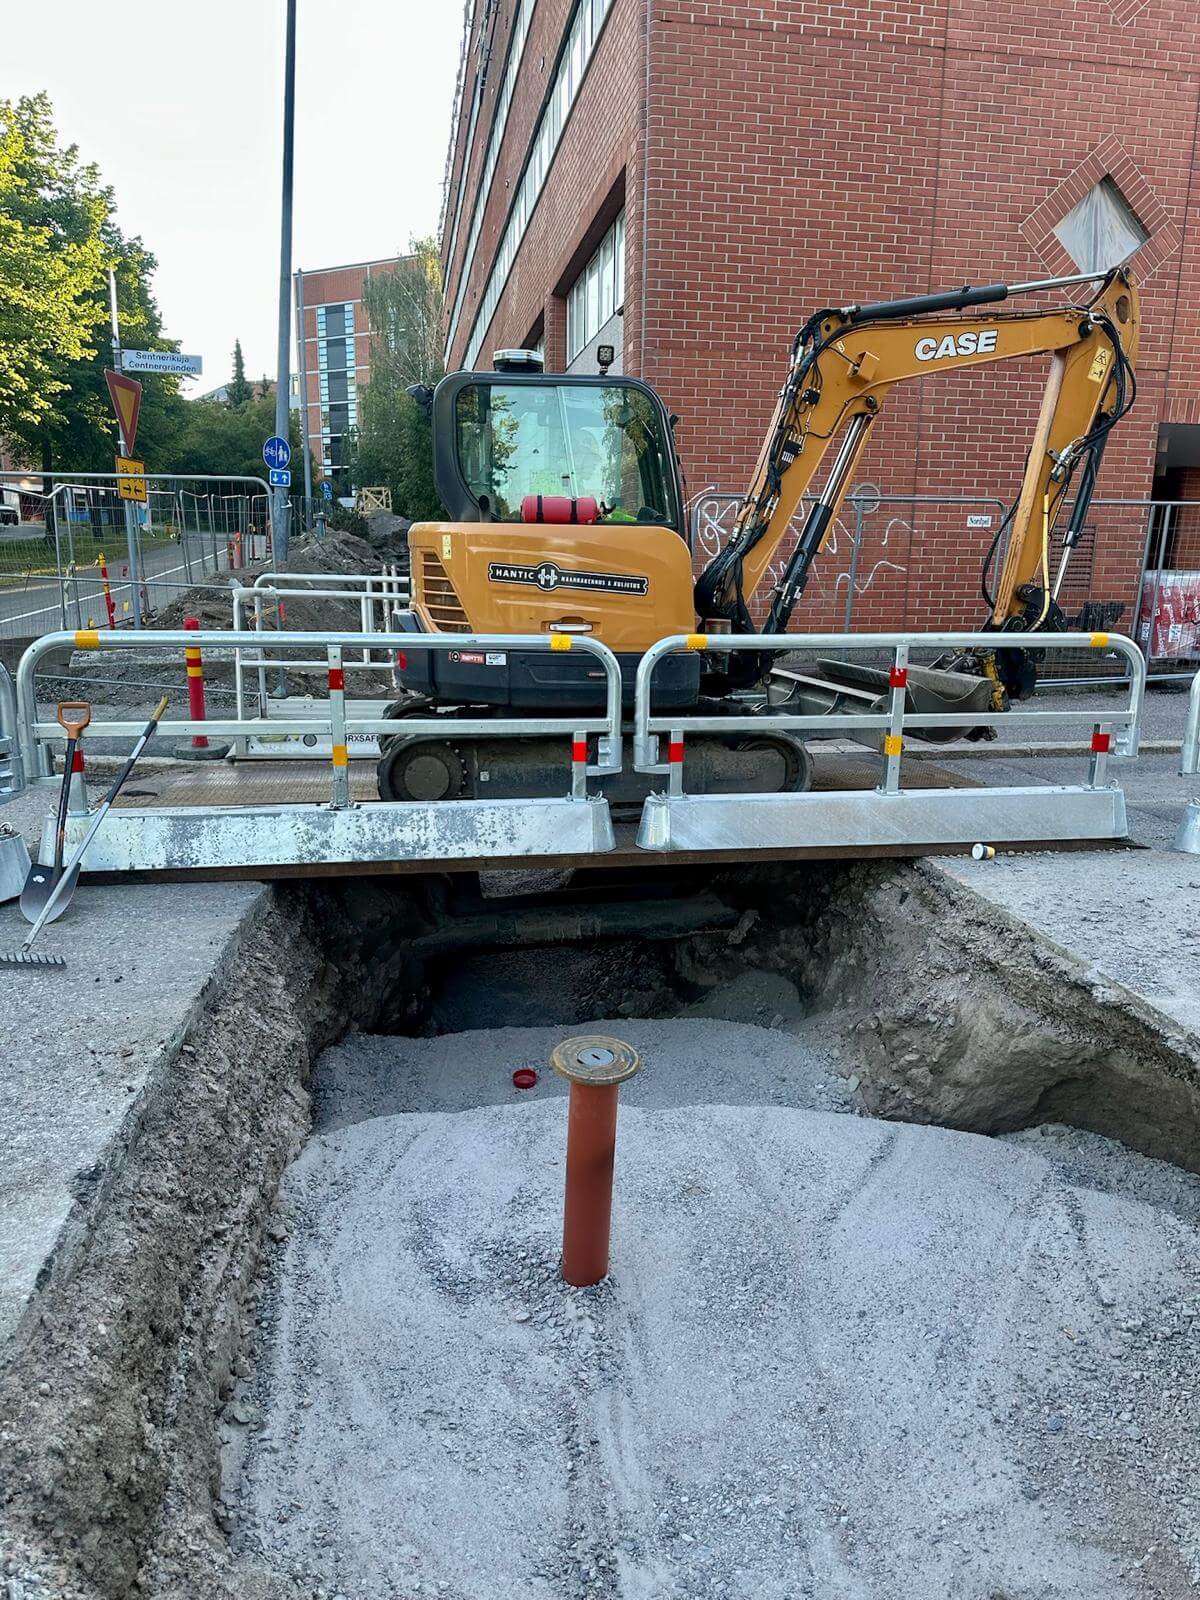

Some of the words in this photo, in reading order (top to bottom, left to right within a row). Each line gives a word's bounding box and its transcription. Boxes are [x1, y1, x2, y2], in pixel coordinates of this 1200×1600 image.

[914, 329, 998, 361] CASE
[135, 352, 189, 363] Sentnerikuja
[495, 569, 535, 580] HANTIC
[344, 734, 379, 743] RXSAF
